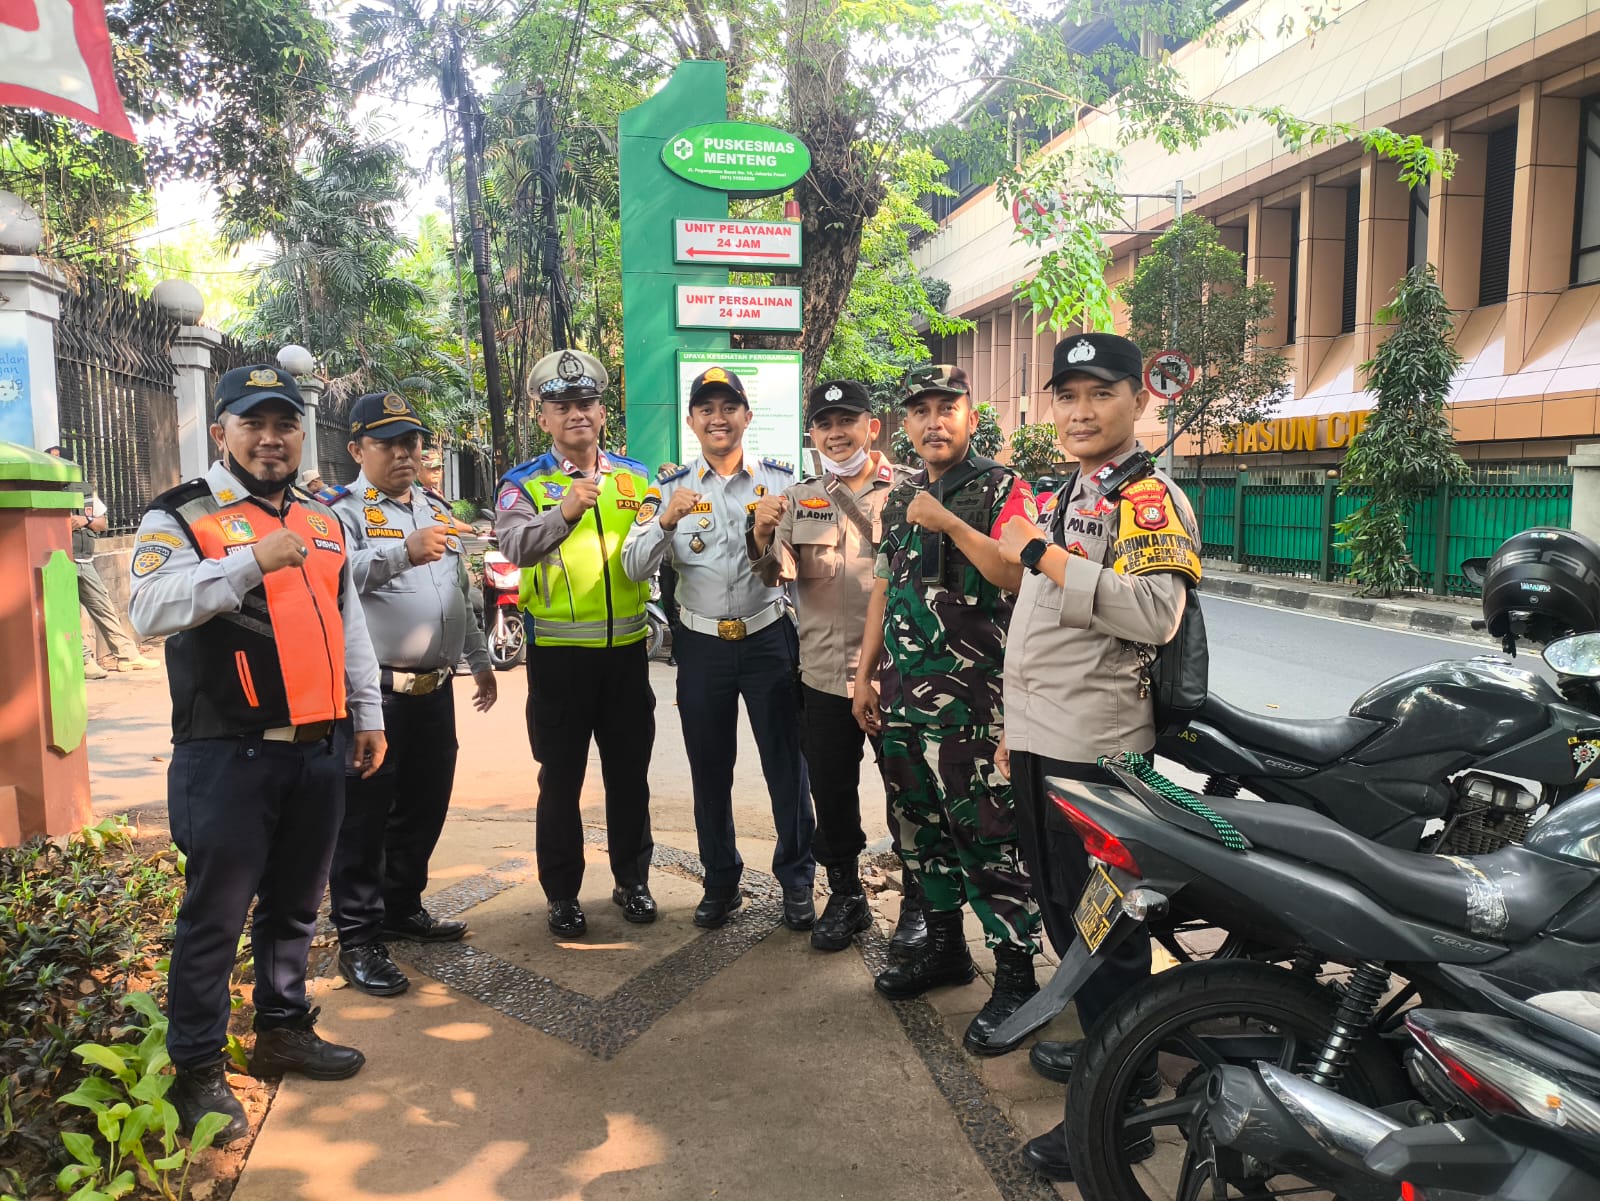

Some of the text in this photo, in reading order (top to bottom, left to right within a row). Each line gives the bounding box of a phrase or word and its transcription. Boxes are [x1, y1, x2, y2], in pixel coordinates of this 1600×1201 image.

[704, 137, 795, 154] PUSKESMAS
[704, 152, 777, 166] MENTENG
[684, 223, 792, 236] UNIT PELAYANAN
[717, 238, 761, 249] 24 JAM
[686, 294, 793, 307] UNIT PERSALINAN
[719, 308, 761, 318] 24 JAM
[796, 509, 834, 521] M.ADHY
[1067, 517, 1103, 537] POLRI
